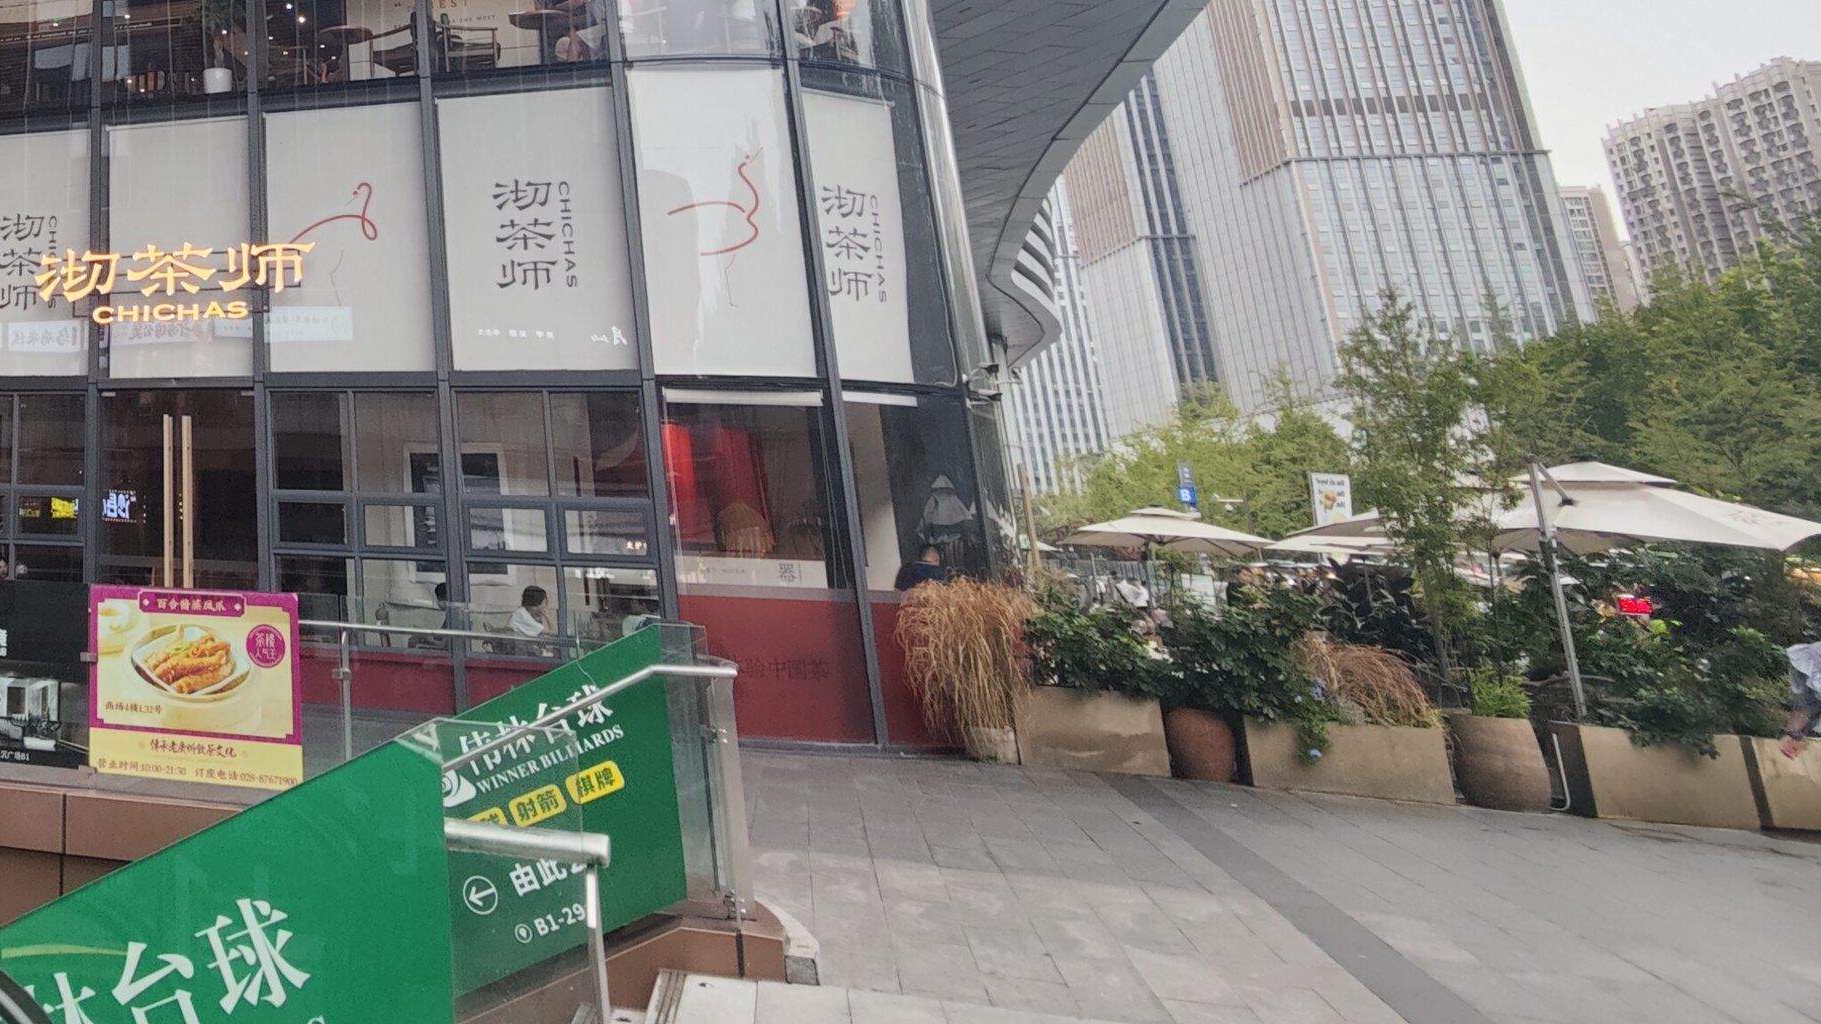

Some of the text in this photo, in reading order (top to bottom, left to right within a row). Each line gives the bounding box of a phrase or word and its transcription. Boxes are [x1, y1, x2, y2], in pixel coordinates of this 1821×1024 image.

[491, 178, 558, 291] 沏茶师
[557, 180, 579, 289] CHICHAS
[33, 241, 317, 303] 沏茶师
[91, 300, 250, 325] CHICHAS
[476, 723, 625, 795] WINNER BILLIARDS
[516, 787, 560, 822] 射箭
[575, 766, 617, 799] 棋牌
